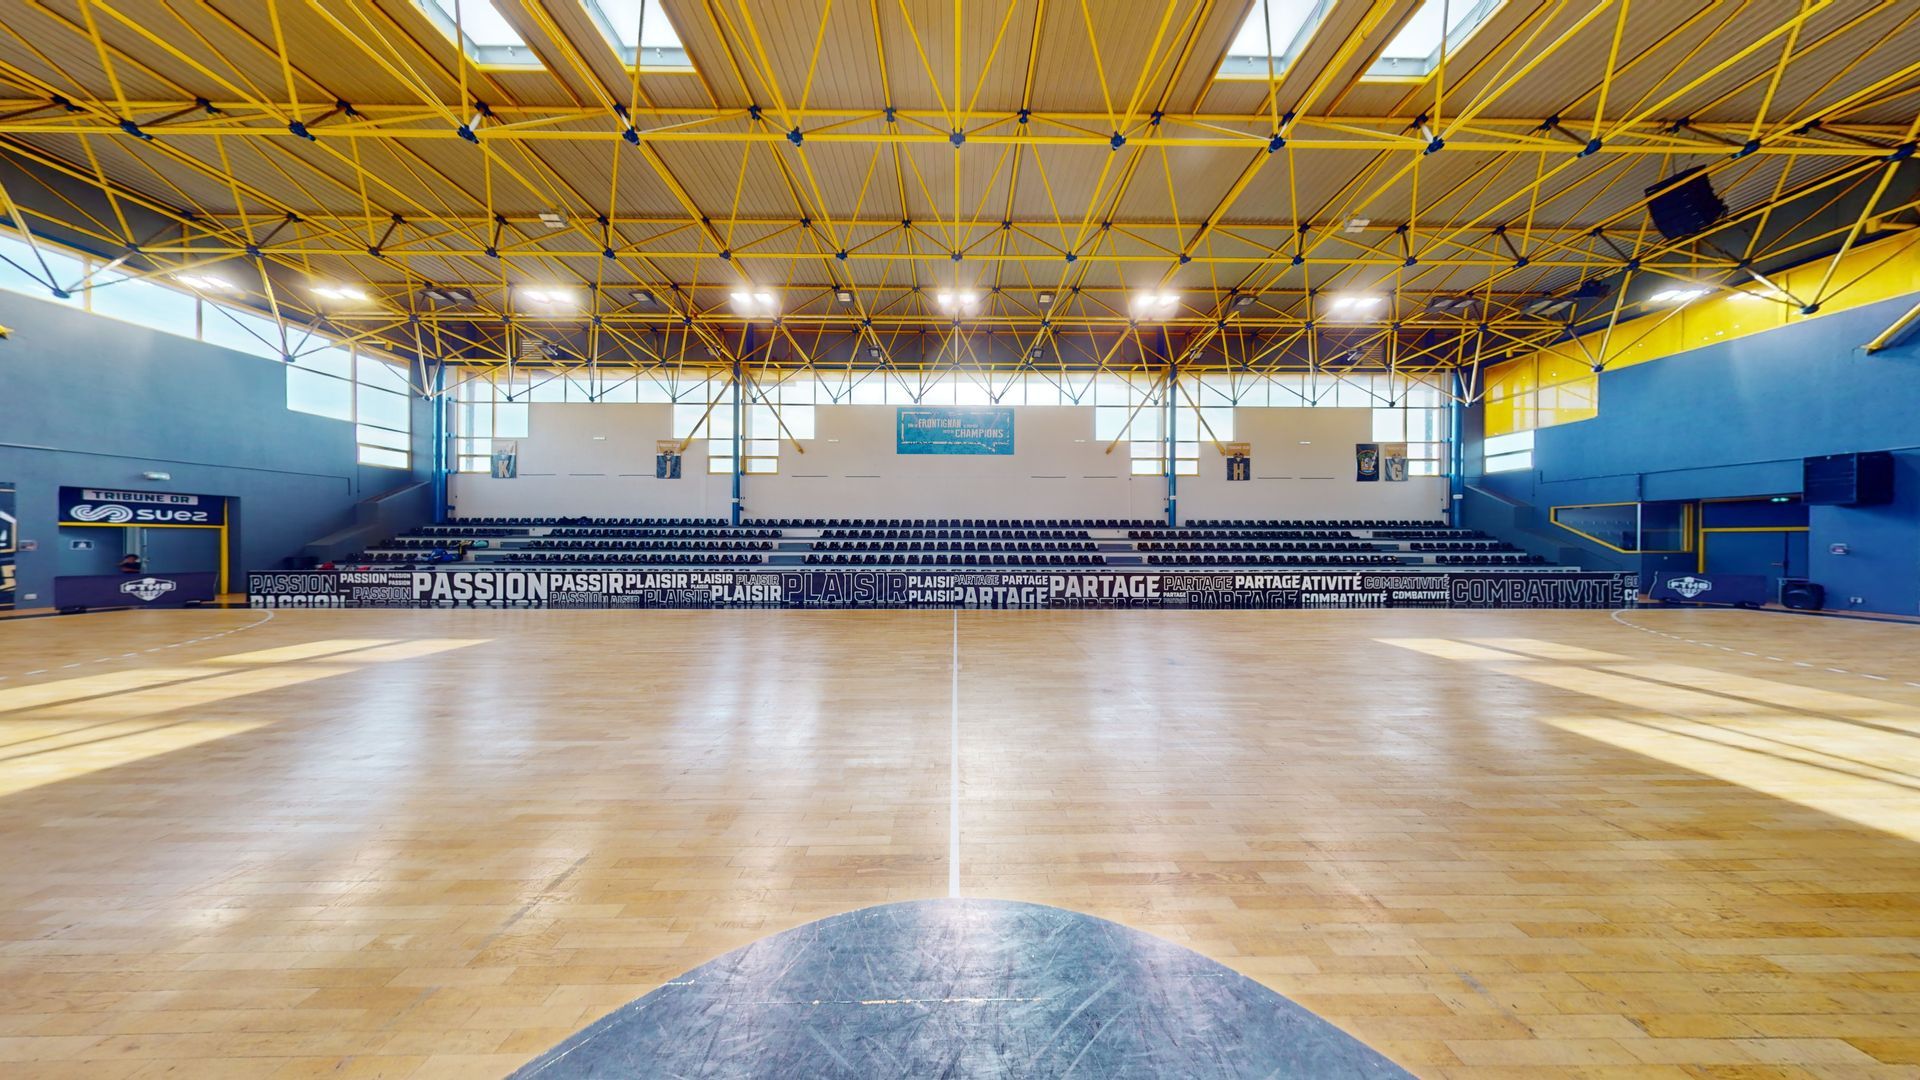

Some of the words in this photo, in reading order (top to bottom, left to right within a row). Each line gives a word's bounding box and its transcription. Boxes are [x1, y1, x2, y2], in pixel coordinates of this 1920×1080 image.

[918, 419, 961, 428] FRONTIGNAN
[955, 429, 1003, 438] CHAMPIONS
[1233, 463, 1244, 481] H
[92, 491, 165, 502] TRIBUNE
[136, 509, 208, 521] suez
[249, 574, 337, 594] PASSION
[340, 573, 387, 583] PASSION
[626, 574, 688, 588] PLAISIR
[691, 574, 733, 584] PLAISIR
[736, 575, 780, 586] PLAISIR
[1002, 575, 1048, 585] PARTAGE
[1163, 576, 1233, 591] PARTAGE
[1235, 575, 1300, 589] PARTAGE
[1301, 572, 1362, 591] ATIVITÉ
[1364, 574, 1450, 590] COMBATIVITÉ
[352, 586, 411, 600] PASSION
[412, 572, 548, 600] PASSION
[711, 585, 782, 601] PLAISIR
[782, 573, 908, 602] PLAISIR
[1050, 575, 1161, 598] PARTAGE
[1452, 573, 1623, 602] COMBATIVITÉ
[954, 587, 1049, 603] PARTAGE
